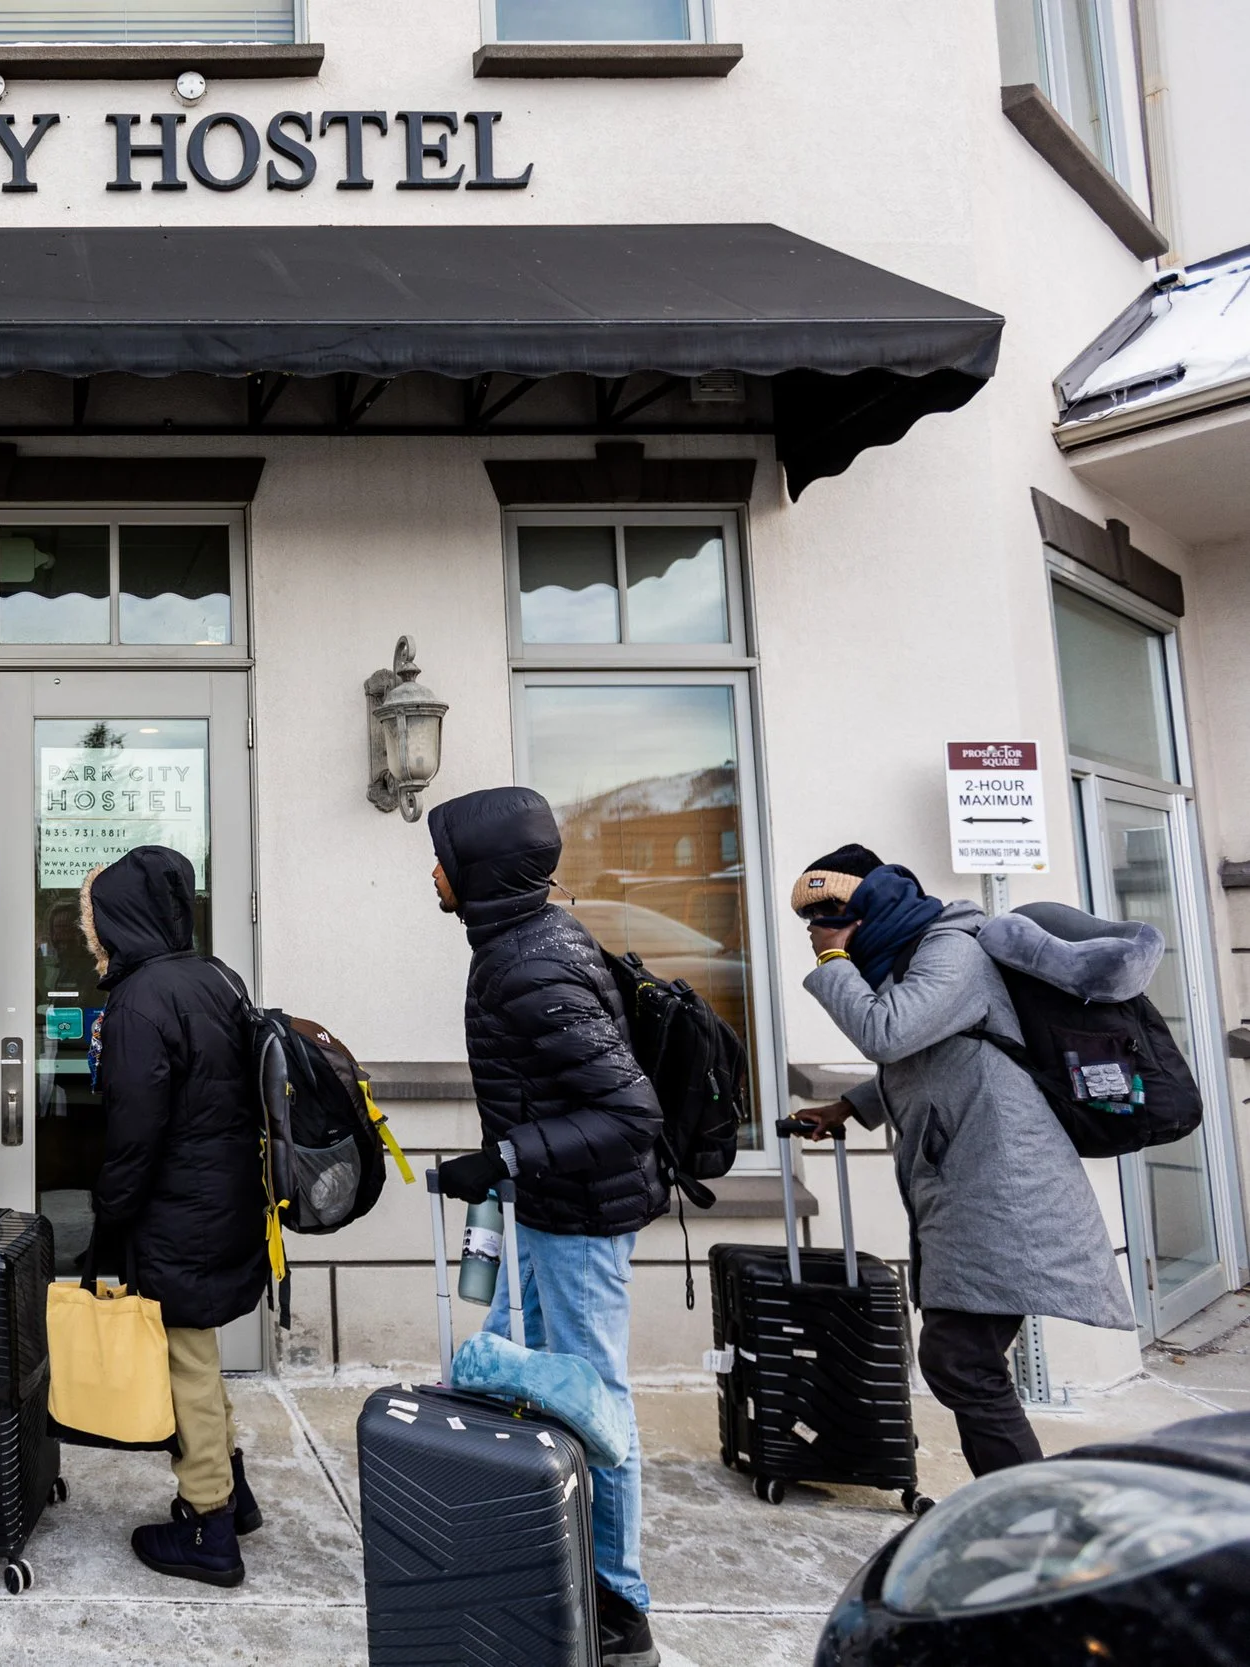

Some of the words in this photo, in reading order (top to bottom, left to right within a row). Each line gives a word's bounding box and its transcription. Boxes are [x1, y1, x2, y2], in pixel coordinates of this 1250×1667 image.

[105, 110, 534, 192] HOSTEL
[962, 745, 1023, 759] PROSPECTOR
[982, 758, 1020, 768] SQUARE
[48, 765, 115, 781] PARK
[129, 766, 190, 782] CITY
[965, 779, 1025, 792] 2-HOUR
[47, 789, 192, 812] HOSTEL
[958, 795, 1033, 806] MAXIMUM
[958, 848, 969, 857] NO
[970, 848, 1002, 857] PARKING
